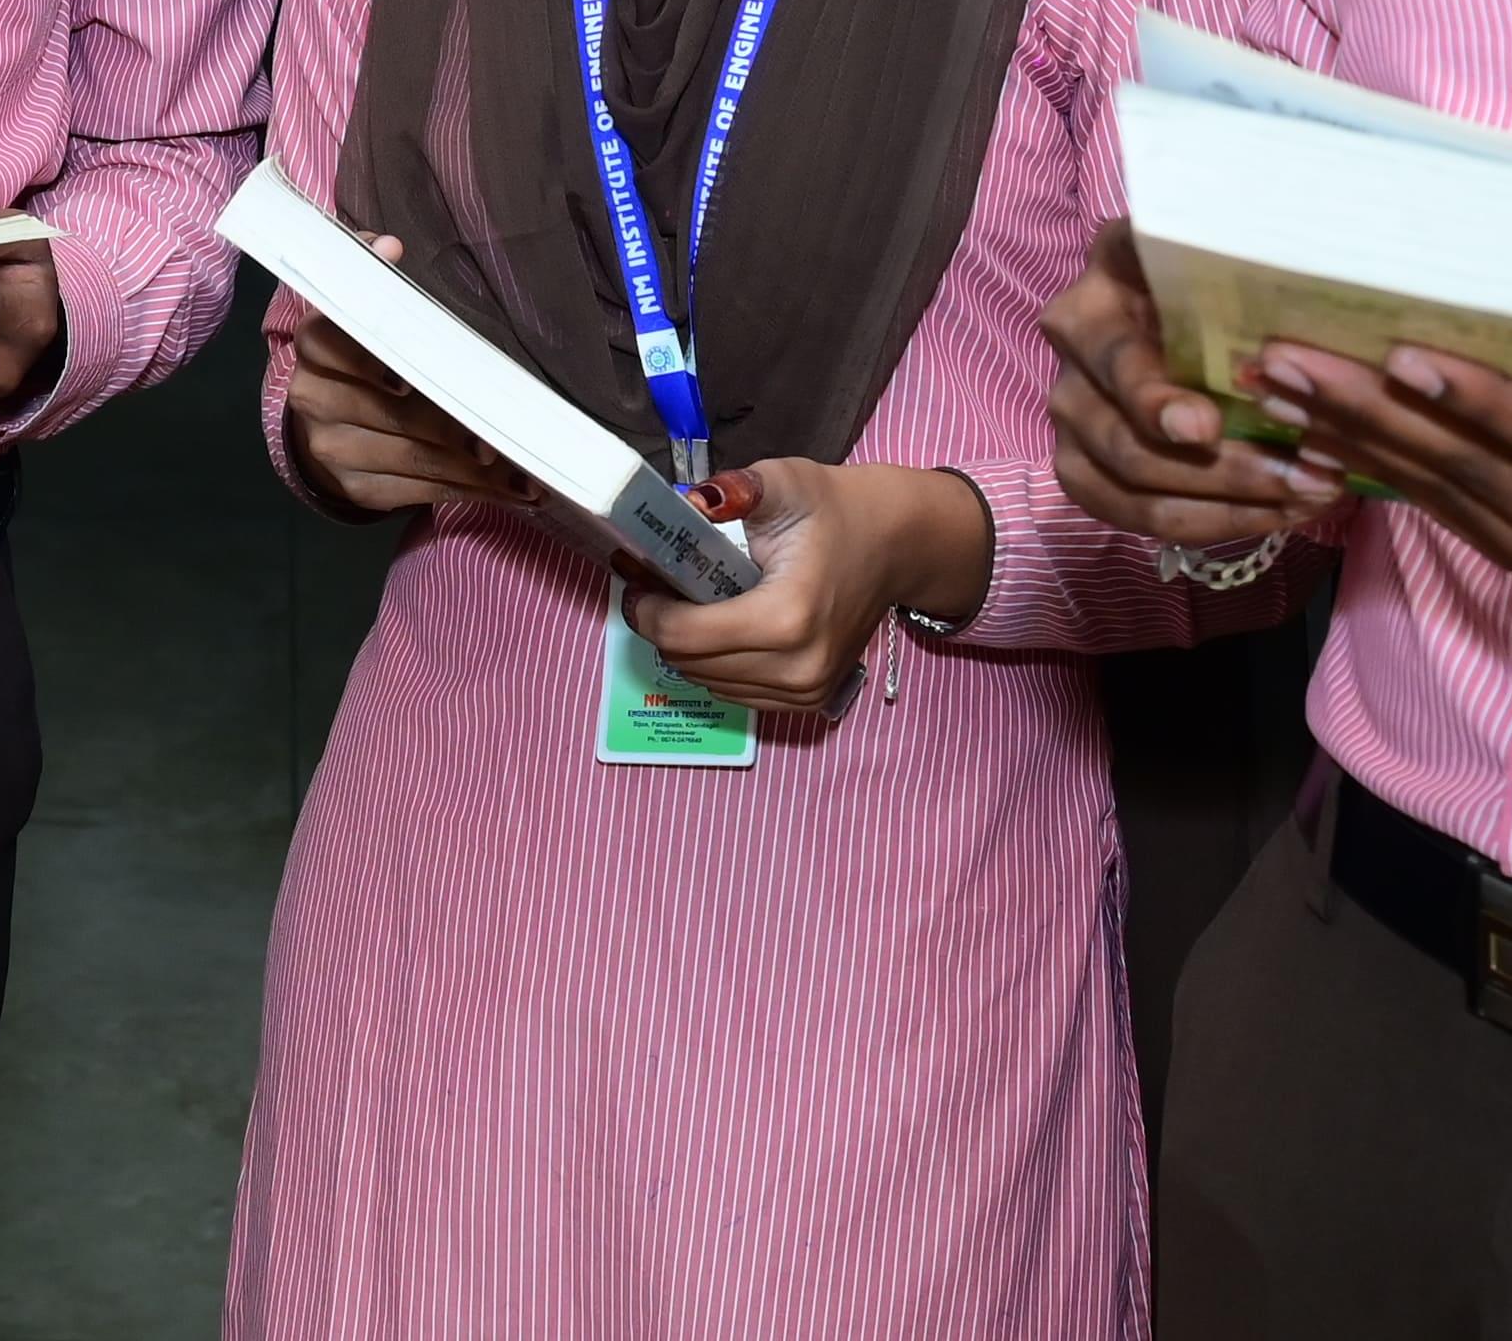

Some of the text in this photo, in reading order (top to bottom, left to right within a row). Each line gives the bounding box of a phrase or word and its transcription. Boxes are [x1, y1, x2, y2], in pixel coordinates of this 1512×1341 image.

[595, 100, 614, 133] OF
[714, 97, 738, 132] OF
[600, 137, 648, 268] INSTITUTE
[632, 273, 662, 316] NM
[633, 501, 714, 581] A course in Highway
[643, 693, 669, 708] NM
